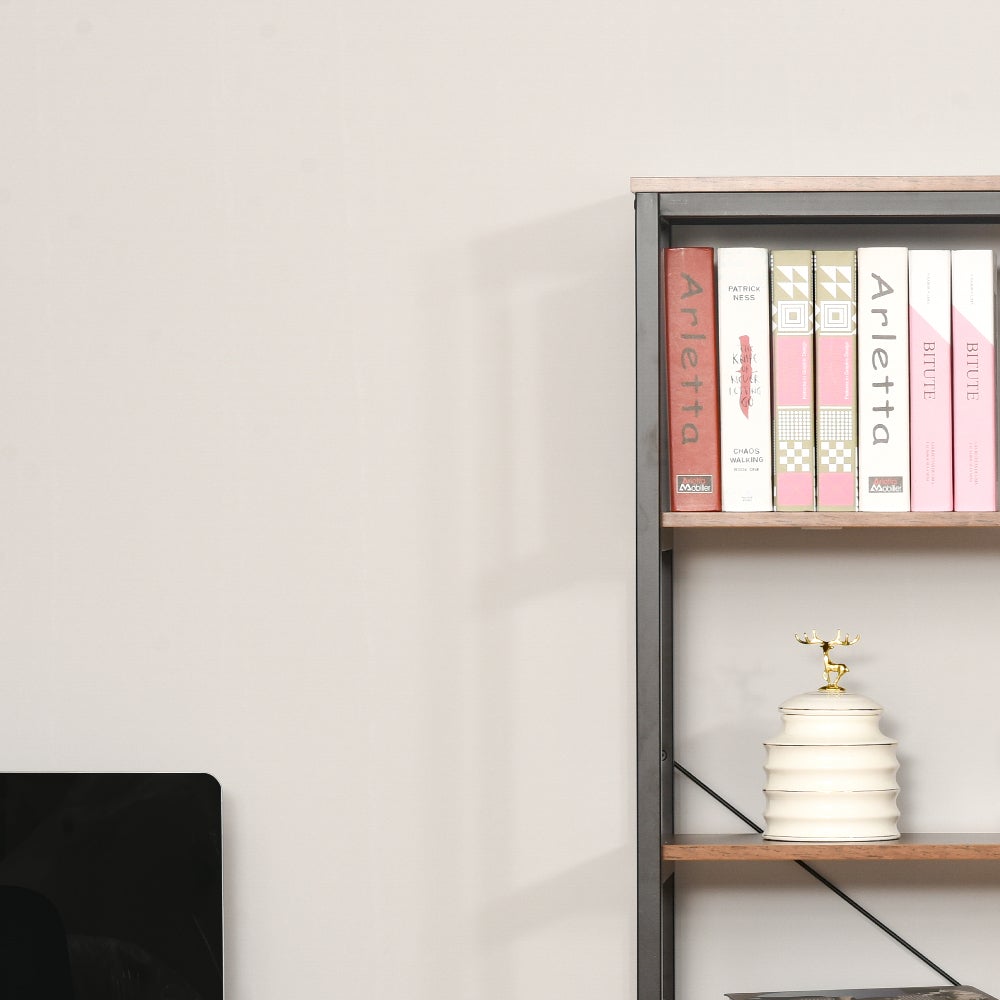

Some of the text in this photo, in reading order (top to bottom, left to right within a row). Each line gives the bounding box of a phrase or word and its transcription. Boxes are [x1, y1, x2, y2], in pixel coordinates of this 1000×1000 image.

[728, 285, 761, 293] PATRICK
[680, 272, 706, 445] Arletta
[871, 272, 896, 446] Arletta
[923, 341, 936, 400] BITUTE
[966, 342, 979, 401] BITUTE
[729, 456, 764, 464] WALKING
